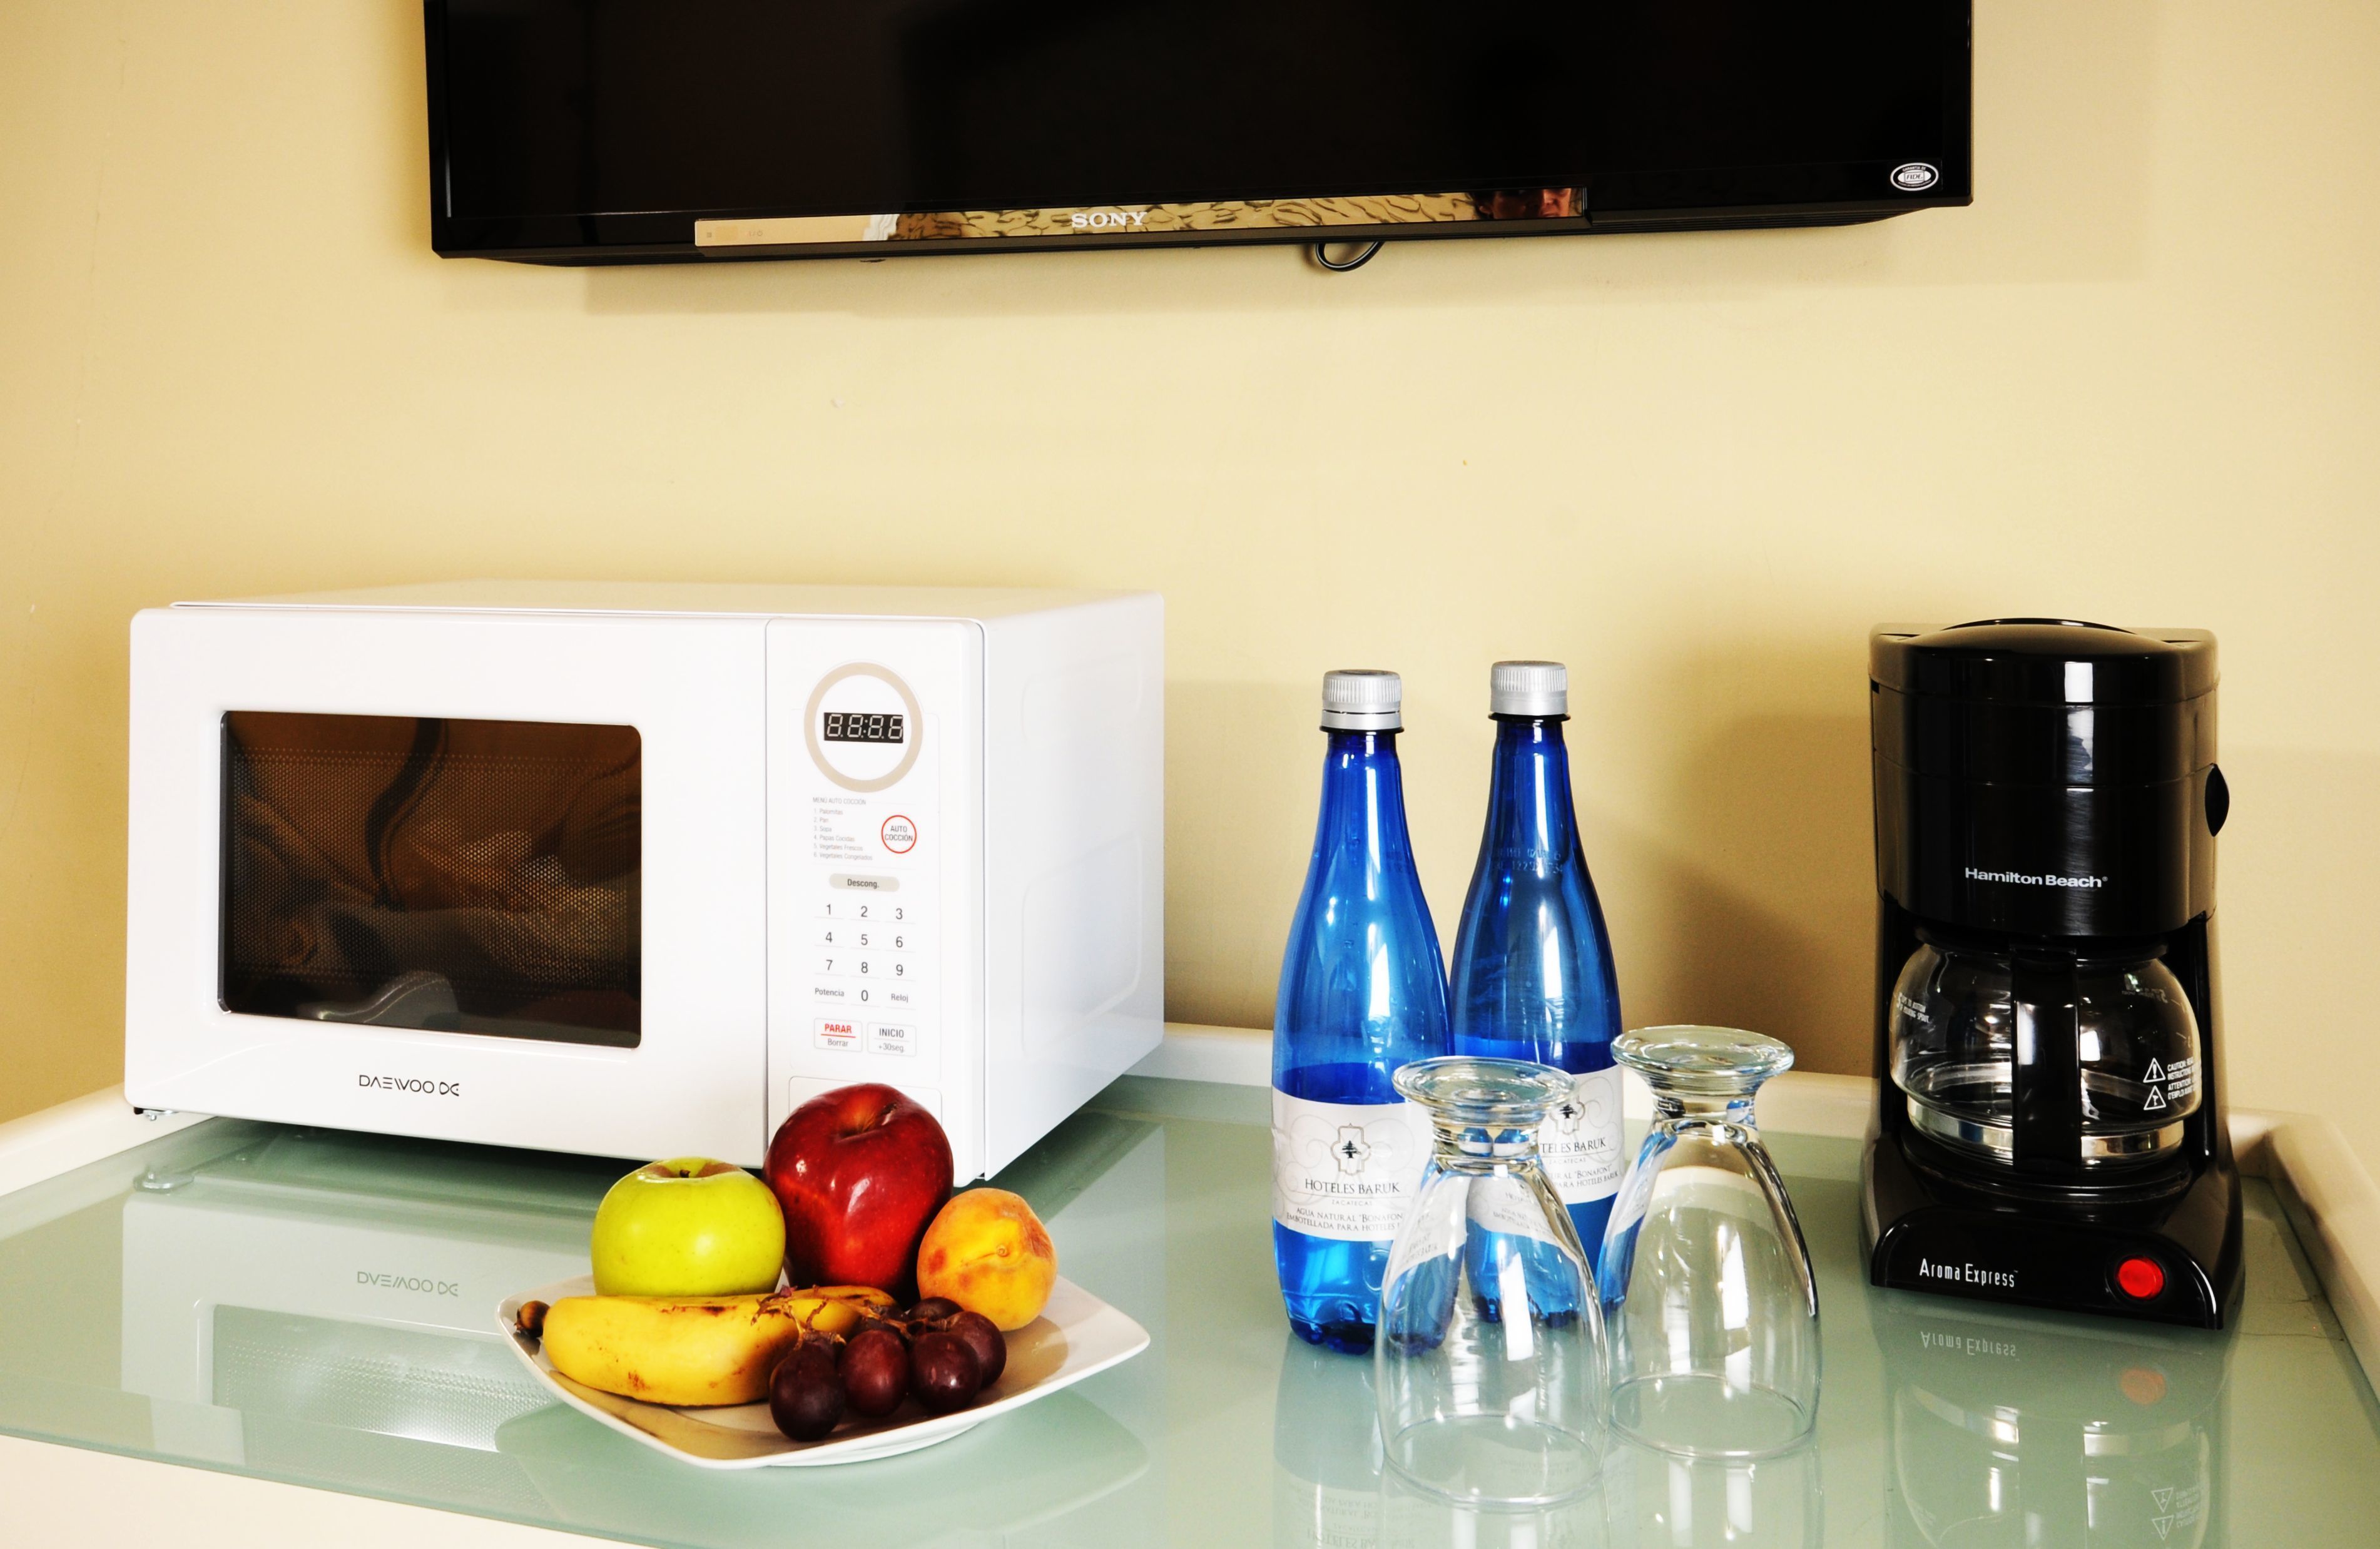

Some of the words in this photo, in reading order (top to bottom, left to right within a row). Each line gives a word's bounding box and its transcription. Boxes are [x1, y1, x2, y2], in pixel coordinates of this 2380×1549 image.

[1070, 211, 1147, 228] SONY
[885, 833, 913, 841] COCCIÓN
[847, 878, 880, 890] Descong.
[1965, 867, 2043, 885] Hamilton
[826, 903, 831, 915] 1
[860, 905, 868, 917] 2
[895, 908, 903, 920] 3
[825, 932, 833, 943] 4
[860, 934, 868, 945] 5
[895, 936, 903, 948] 6
[825, 959, 833, 971] 7
[861, 962, 868, 973] 8
[895, 964, 903, 976] 9
[815, 987, 845, 997] Potencia
[861, 990, 868, 1002] 0
[891, 993, 908, 1003] Reloj
[824, 1023, 852, 1034] PARAR
[879, 1028, 904, 1038] INICIO
[827, 1038, 848, 1047] Borrar
[359, 1074, 435, 1094] DAEWOO
[1540, 1142, 1571, 1154] TELES
[1574, 1137, 1606, 1152] BARUK
[1305, 1178, 1355, 1194] HOTELES
[1358, 1182, 1401, 1194] BARUK
[1577, 1176, 1602, 1187] HOTELES
[1286, 1212, 1335, 1229] EMBOTELLADA
[1337, 1224, 1359, 1232] PARA
[1362, 1222, 1395, 1232] HOTELES
[1296, 1207, 1315, 1217] AGUA
[1317, 1212, 1357, 1222] NATURAL
[1919, 1257, 1960, 1281] Aroma
[1965, 1263, 2015, 1288] Express
